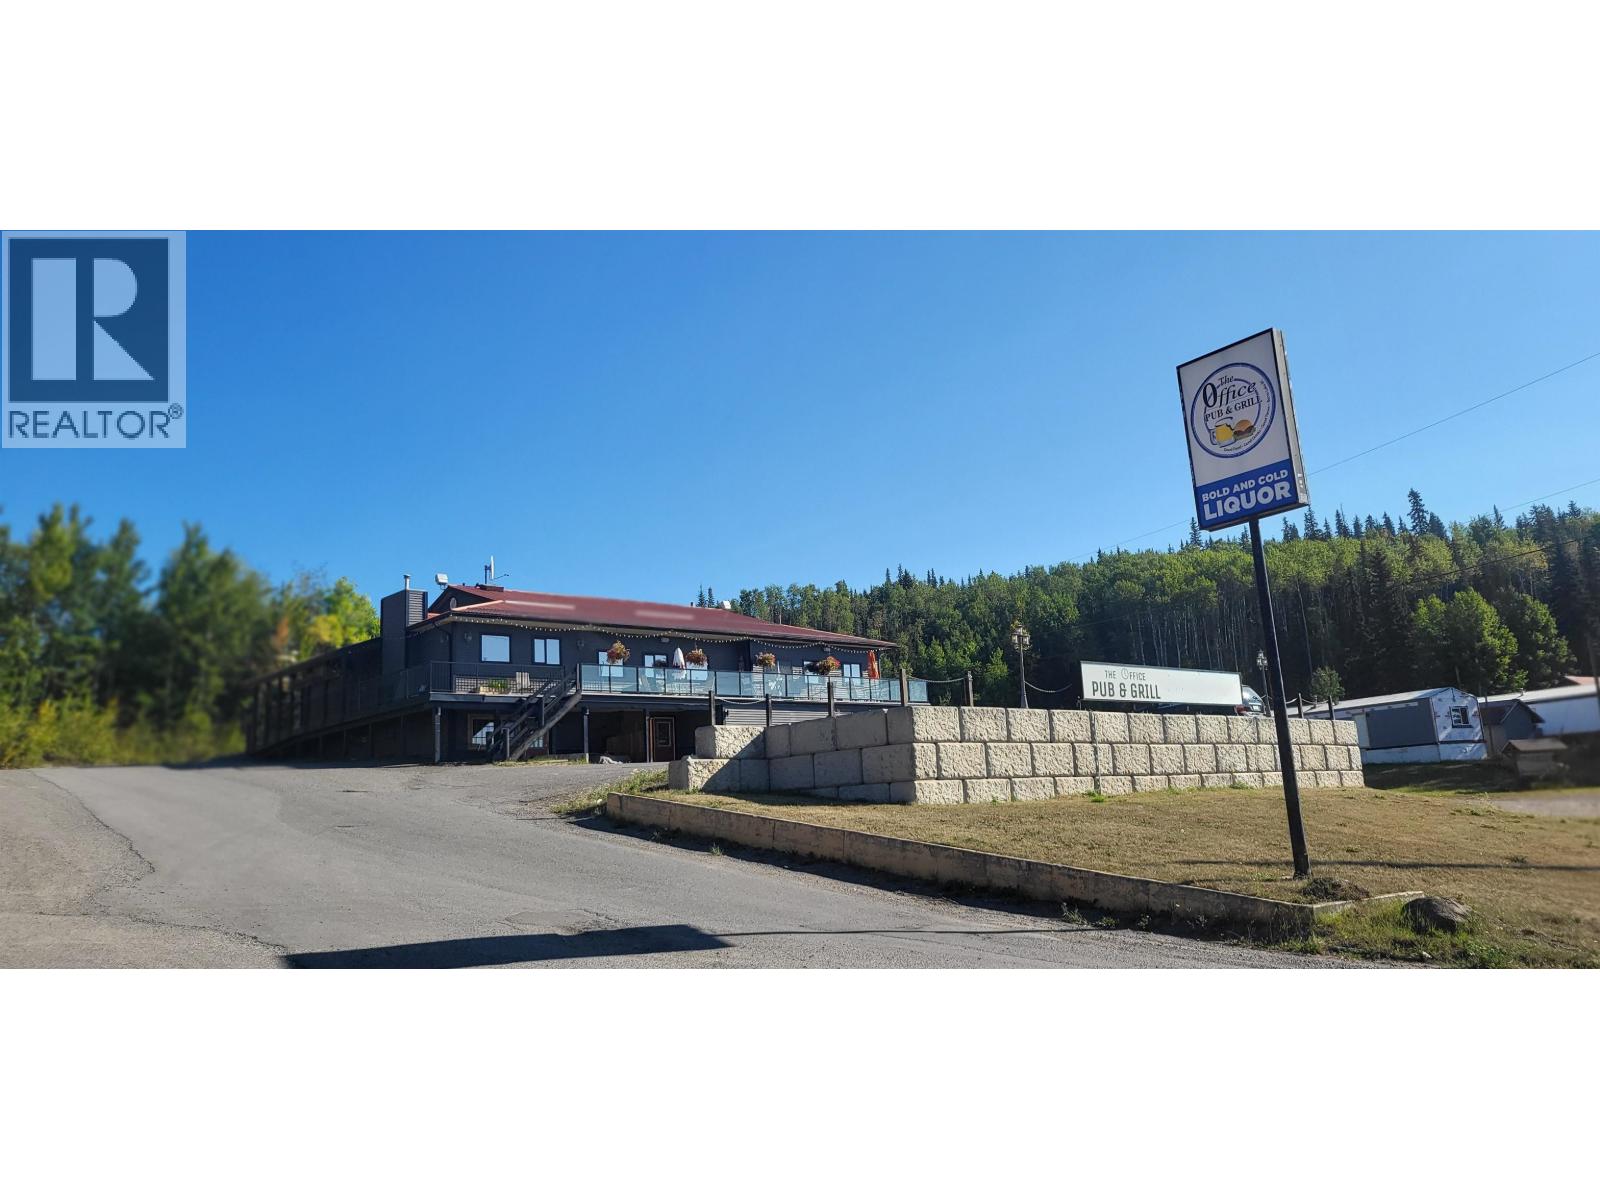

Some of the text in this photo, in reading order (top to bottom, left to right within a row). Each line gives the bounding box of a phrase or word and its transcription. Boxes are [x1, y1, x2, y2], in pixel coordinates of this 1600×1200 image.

[1219, 375, 1234, 386] The
[1202, 382, 1256, 408] Office
[1204, 397, 1262, 422] PUB & GRILL
[1201, 469, 1288, 502] BOLD AND COLD
[1203, 481, 1292, 521] LIQUOR
[1105, 669, 1116, 679] THE
[1092, 681, 1161, 699] PUB & GRILL
